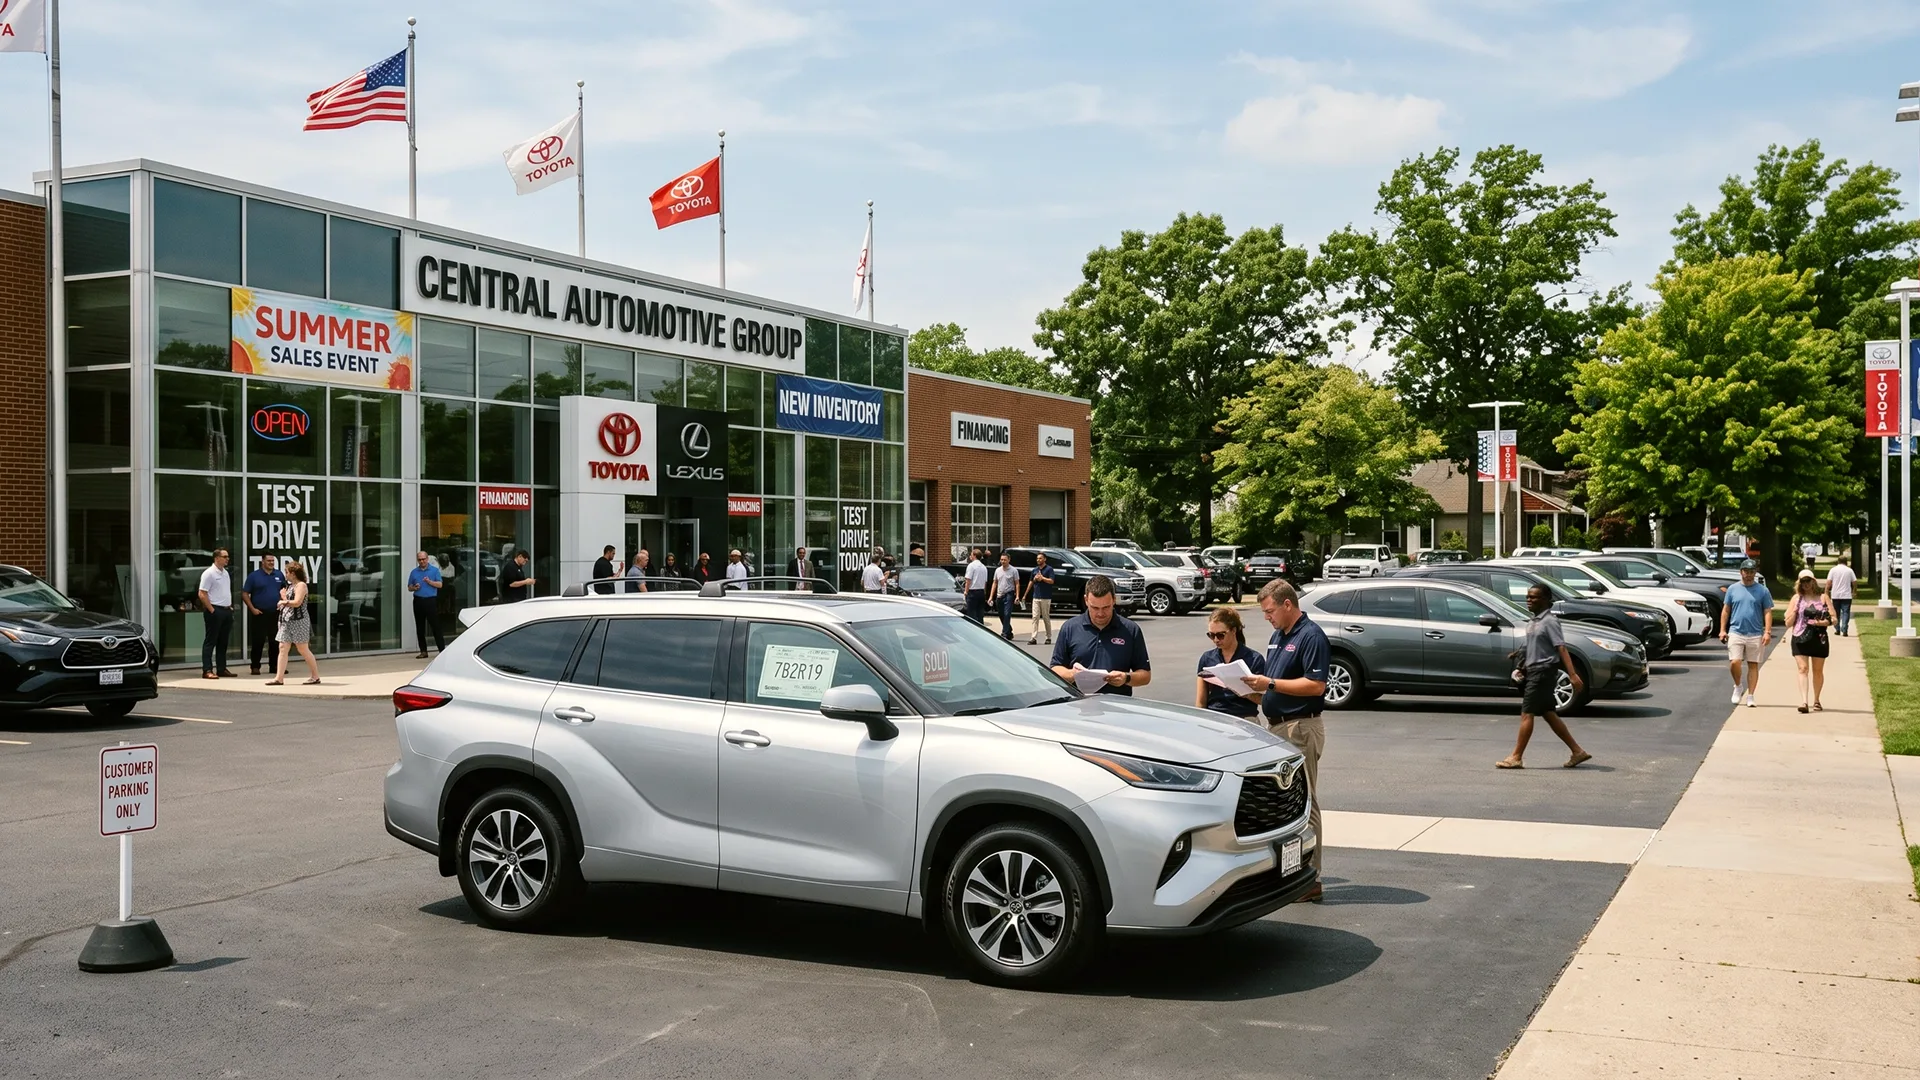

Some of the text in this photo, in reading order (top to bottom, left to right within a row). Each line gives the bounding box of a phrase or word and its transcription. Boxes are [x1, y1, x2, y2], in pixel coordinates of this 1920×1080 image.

[526, 157, 574, 183] TOYOTA
[668, 196, 712, 215] TOYOTA
[417, 255, 803, 360] CENTRAL AUTOMOTIVE GROUP
[255, 305, 392, 354] SUMMER
[270, 345, 379, 374] SALES EVENT
[779, 389, 881, 426] NEW INVENTORY
[1877, 373, 1888, 431] TOYOTA
[253, 409, 306, 436] OPEN
[958, 420, 1008, 445] FINANCING
[588, 461, 649, 482] TOYOTA
[666, 464, 724, 481] LEXUS
[257, 483, 315, 514] TEST
[479, 491, 529, 507] FINANCING
[843, 506, 867, 526] TEST
[252, 520, 321, 550] DRIVE
[840, 529, 869, 549] DRIVE
[839, 551, 871, 572] TODAY
[774, 661, 823, 681] 7B2R19
[924, 650, 948, 673] SOLD
[104, 761, 154, 779] CUSTOMER
[108, 781, 149, 800] PARKING
[116, 802, 141, 819] ONLY
